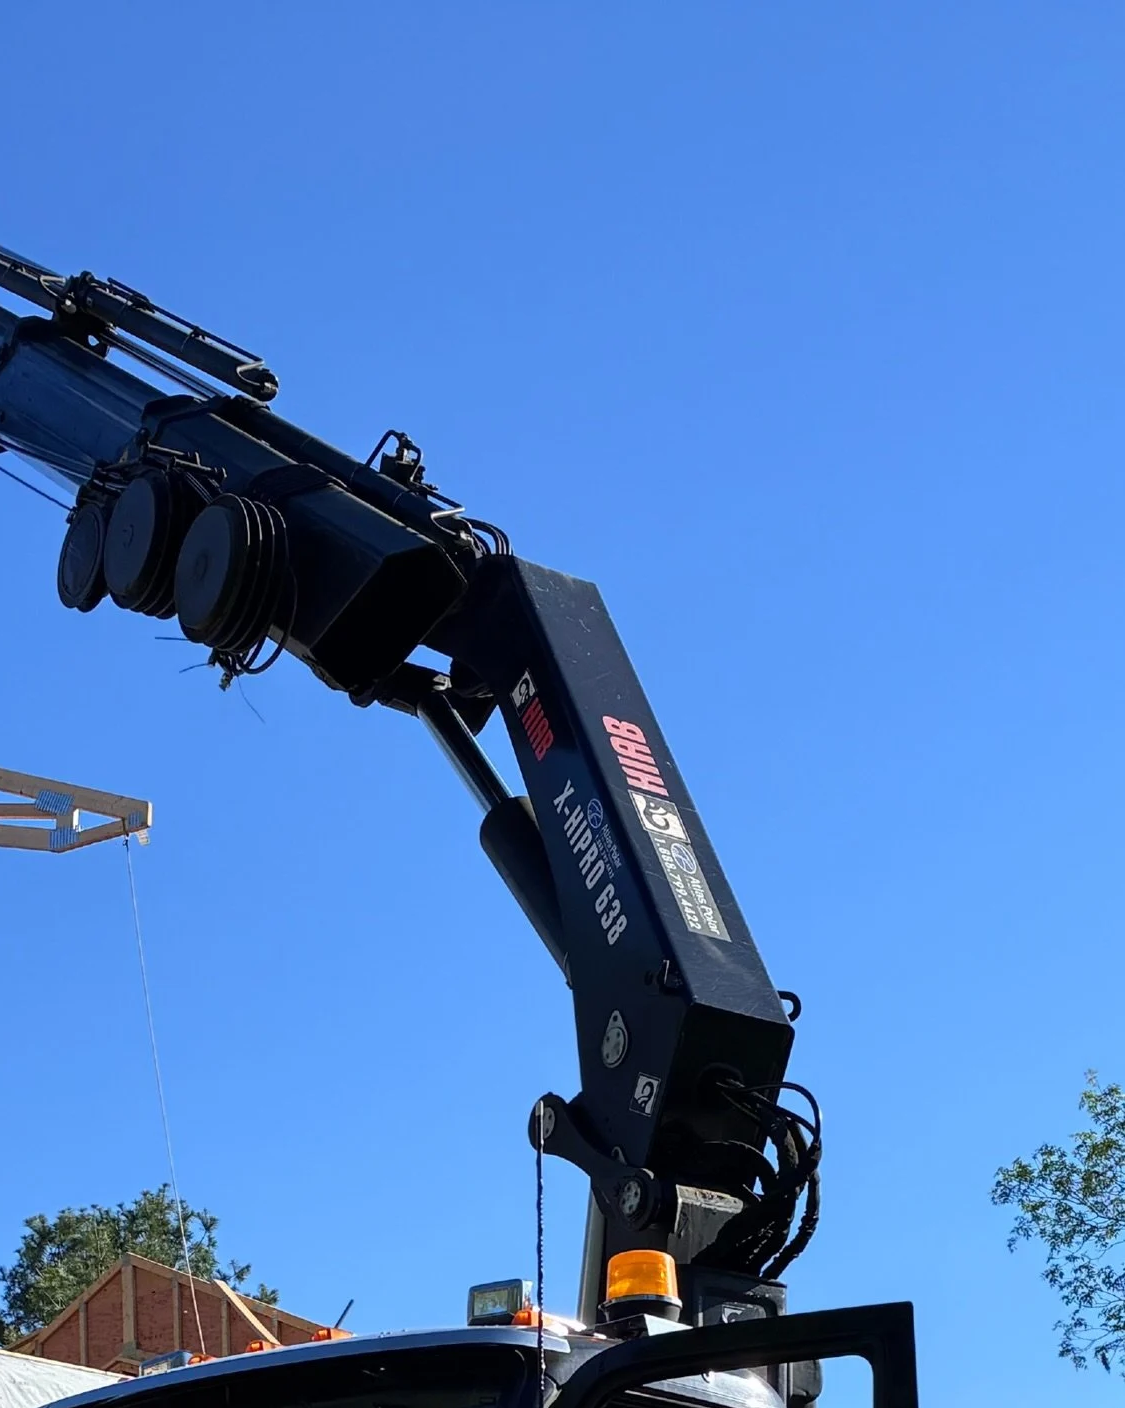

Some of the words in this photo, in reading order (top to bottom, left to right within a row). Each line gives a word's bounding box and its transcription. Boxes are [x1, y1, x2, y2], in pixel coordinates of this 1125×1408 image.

[522, 696, 554, 761] HIAB
[602, 715, 669, 797] HIAB
[553, 778, 605, 890] X-HIPRO
[595, 882, 627, 945] 638
[654, 837, 702, 930] 1.888.799.4422
[688, 876, 708, 906] Atlas
[698, 901, 720, 936] Polar
